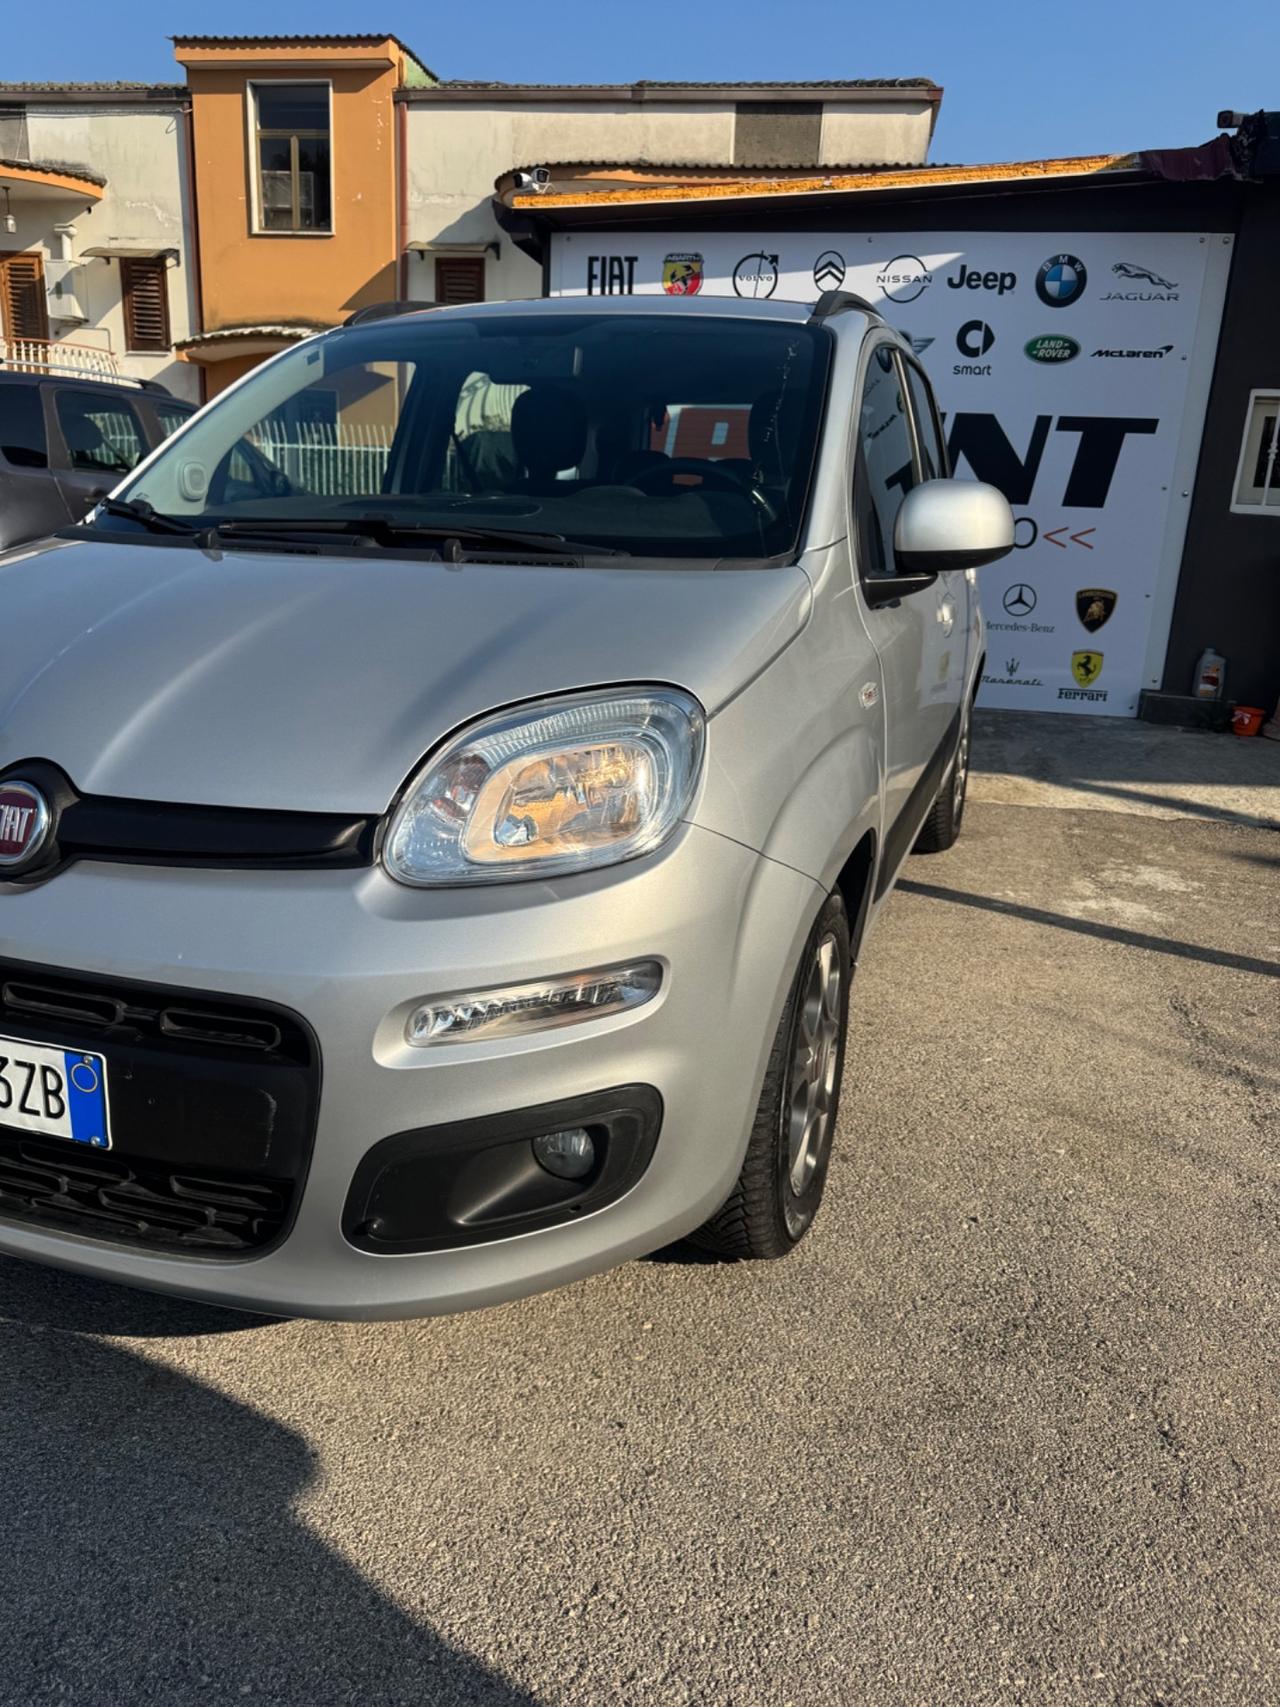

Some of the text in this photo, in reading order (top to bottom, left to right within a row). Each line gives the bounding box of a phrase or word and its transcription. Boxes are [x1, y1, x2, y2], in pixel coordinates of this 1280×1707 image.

[587, 256, 639, 296] FIAT
[876, 275, 933, 283] NISSAN
[947, 264, 1017, 295] Jeep
[1099, 293, 1180, 301] JAGUAR
[1089, 348, 1164, 359] McLaren
[953, 364, 992, 376] smart
[941, 412, 1160, 508] NT
[1057, 687, 1109, 701] Ferrari
[0, 804, 34, 843] IAT
